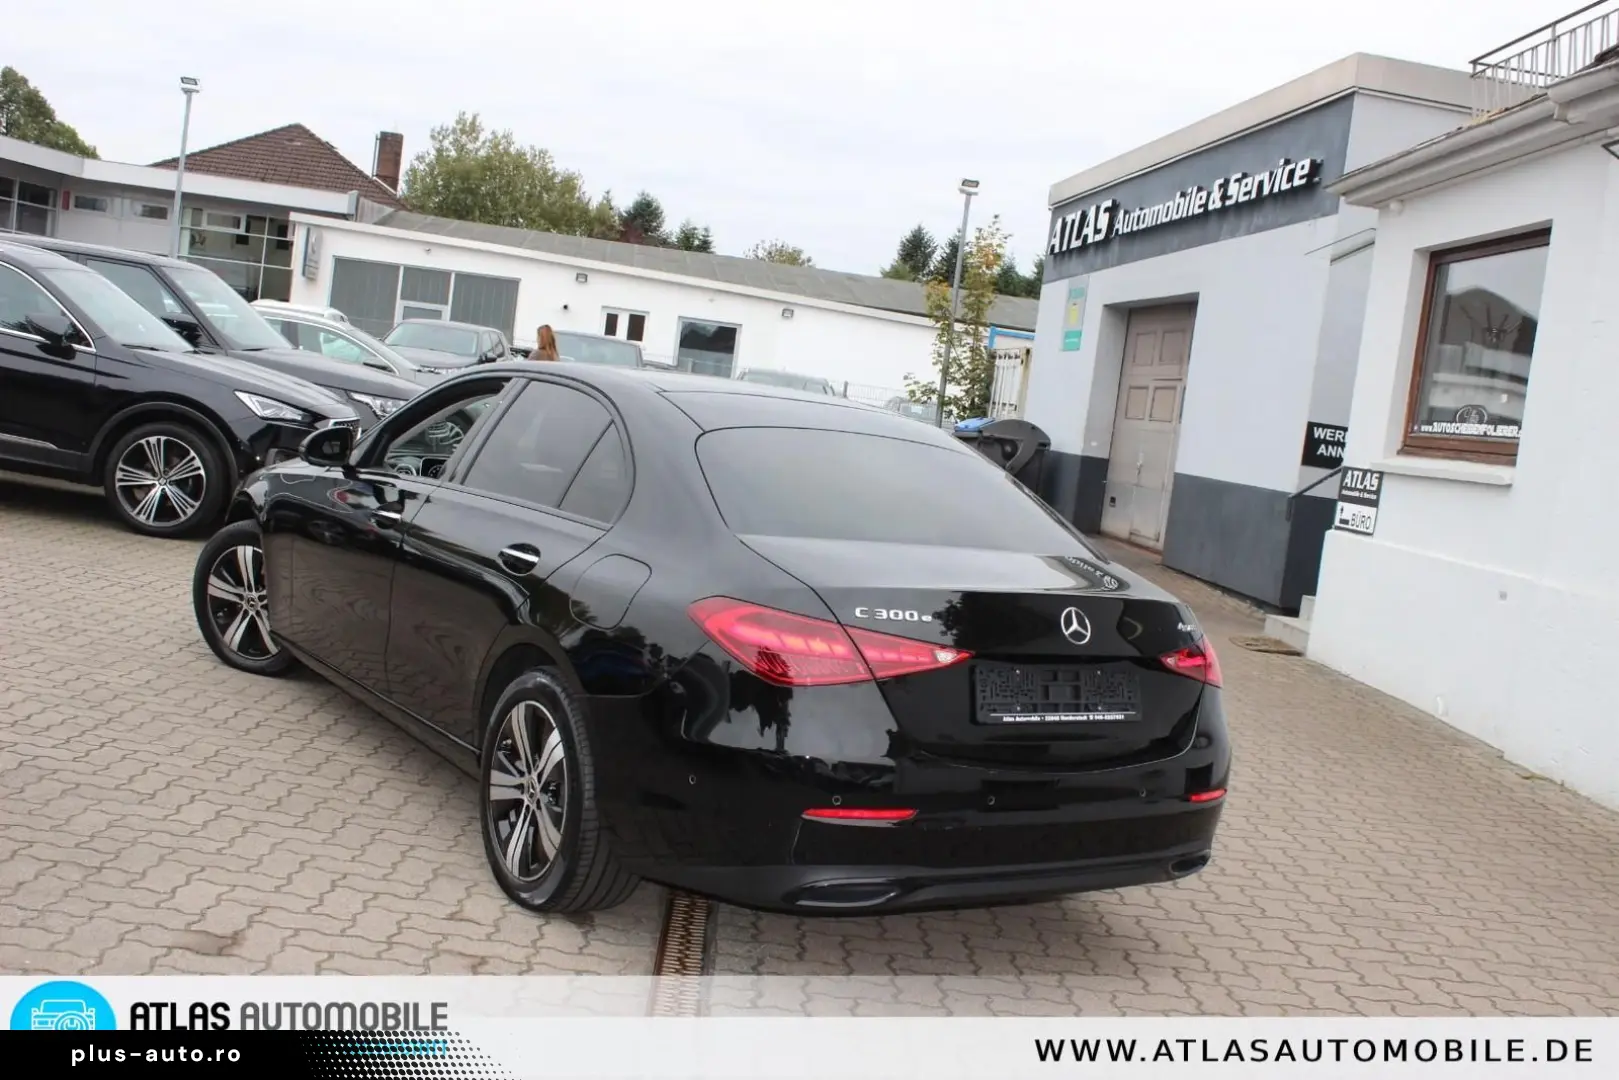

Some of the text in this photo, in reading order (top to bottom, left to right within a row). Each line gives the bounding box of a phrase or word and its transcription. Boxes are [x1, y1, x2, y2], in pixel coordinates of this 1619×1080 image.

[1048, 158, 1310, 255] ATLAS Automobile & Service
[1342, 469, 1379, 491] ATLAS
[1350, 510, 1371, 530] BÜRO
[855, 607, 869, 618] C
